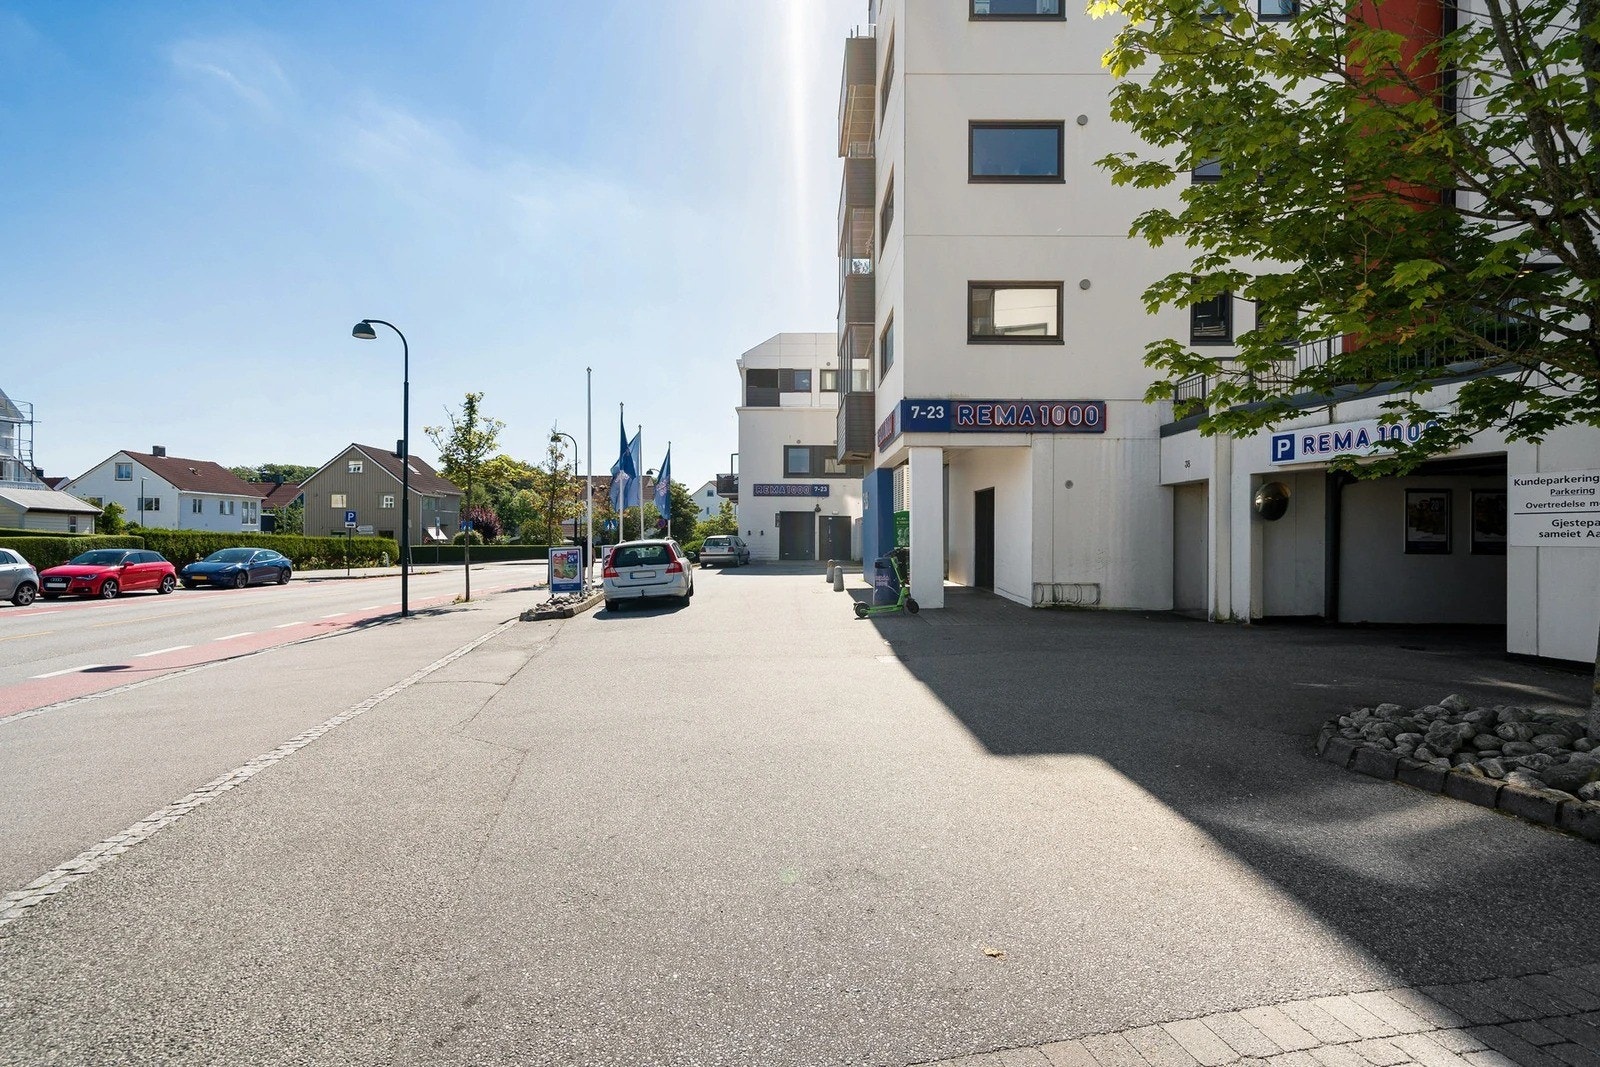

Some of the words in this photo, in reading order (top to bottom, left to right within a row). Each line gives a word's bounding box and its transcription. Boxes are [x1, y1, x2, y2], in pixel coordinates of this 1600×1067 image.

[911, 405, 945, 419] 7-23
[957, 404, 1036, 426] REMA
[1040, 404, 1099, 426] 1000
[1277, 439, 1291, 459] P
[1302, 428, 1370, 455] REMA
[1514, 474, 1600, 486] Kundeparkering
[755, 485, 786, 495] REMA
[1550, 487, 1596, 496] Parkering
[1525, 500, 1586, 509] Overtredelse
[348, 512, 355, 521] P
[1538, 530, 1582, 538] sameiet
